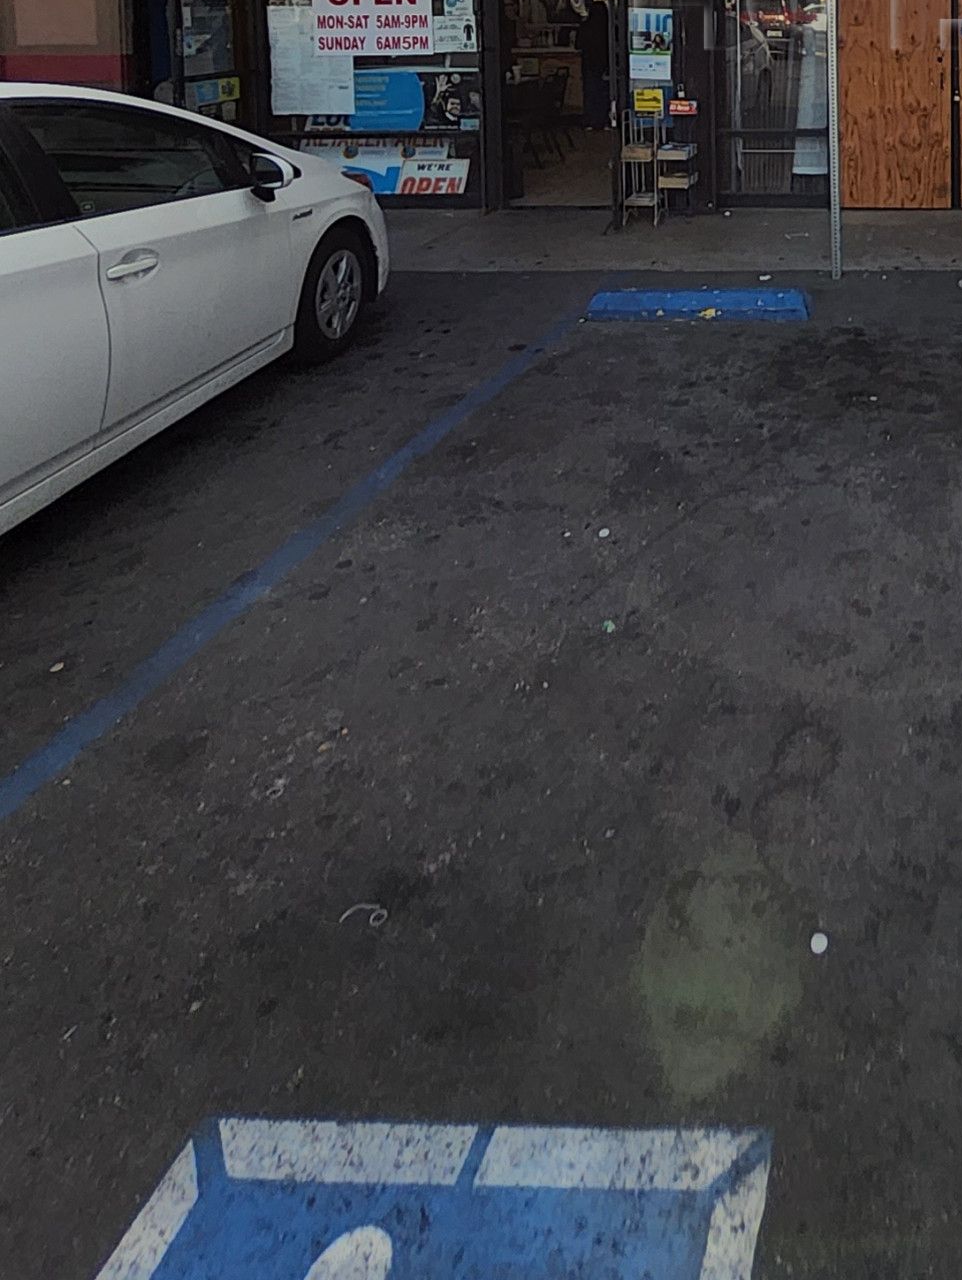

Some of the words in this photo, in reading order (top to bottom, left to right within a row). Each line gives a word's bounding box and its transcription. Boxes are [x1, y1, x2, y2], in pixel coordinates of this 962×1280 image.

[317, 14, 370, 29] MON-SAT
[376, 14, 429, 28] 5AM-9PM
[318, 36, 366, 51] SUNDAY
[417, 163, 452, 171] WE'RE
